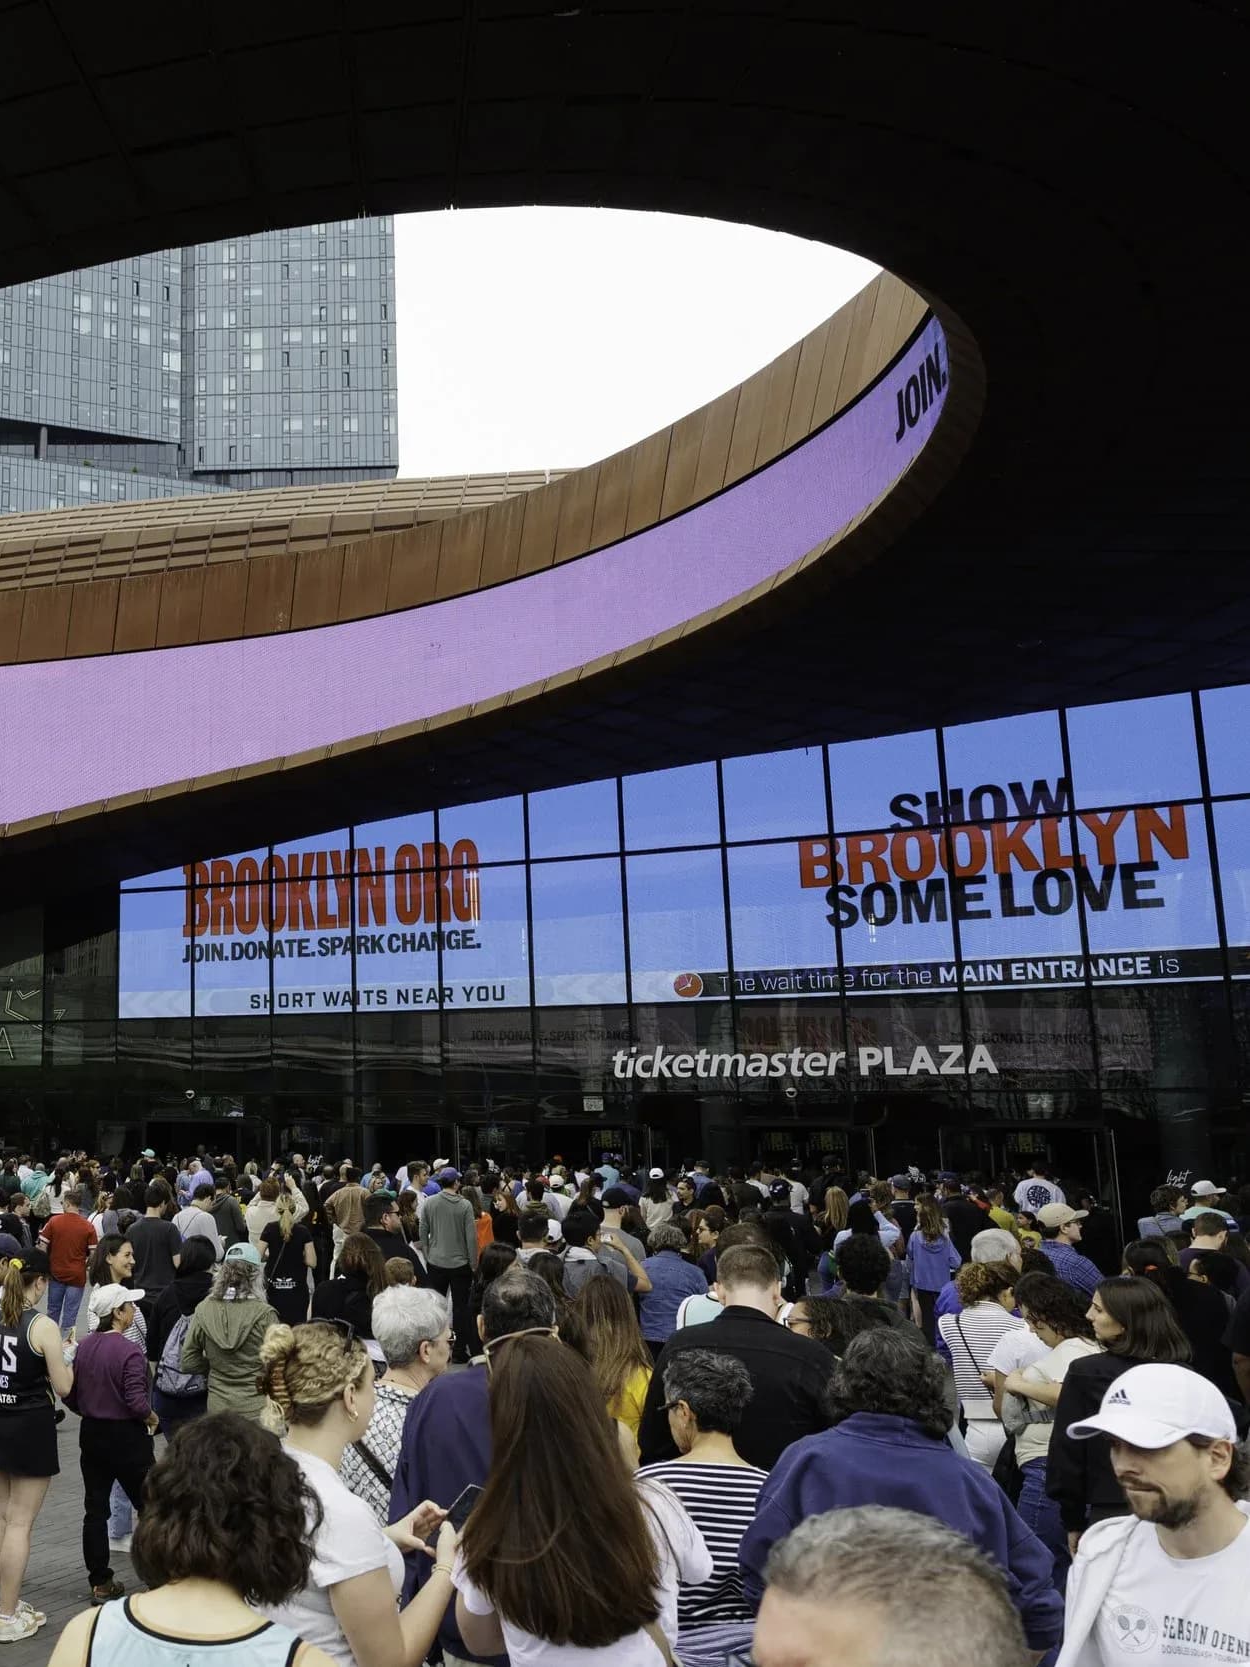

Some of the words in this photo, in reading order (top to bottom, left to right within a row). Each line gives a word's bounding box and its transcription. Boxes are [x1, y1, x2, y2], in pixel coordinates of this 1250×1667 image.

[895, 342, 947, 443] JOIN.
[889, 777, 1071, 833] SHOW
[798, 804, 1189, 888] BROOKLYN
[182, 845, 387, 937] BROOKLYN
[395, 838, 482, 925] ORG
[825, 875, 992, 929] SOME
[999, 861, 1165, 919] LOVE
[317, 934, 385, 957] SPARK
[388, 929, 482, 953] CHANGE.
[760, 971, 803, 990] wait
[861, 968, 891, 987] for
[897, 966, 932, 985] the
[940, 963, 1003, 984] MAIN
[1011, 956, 1152, 981] ENTRANCE
[1158, 954, 1180, 975] is
[250, 991, 316, 1010] SHORT
[323, 989, 388, 1008] WAITS
[396, 987, 454, 1005] NEAR
[462, 985, 506, 1002] YOU
[612, 1045, 846, 1079] ticketmaster
[858, 1044, 999, 1076] PLAZA
[1162, 1615, 1209, 1645] SEASON
